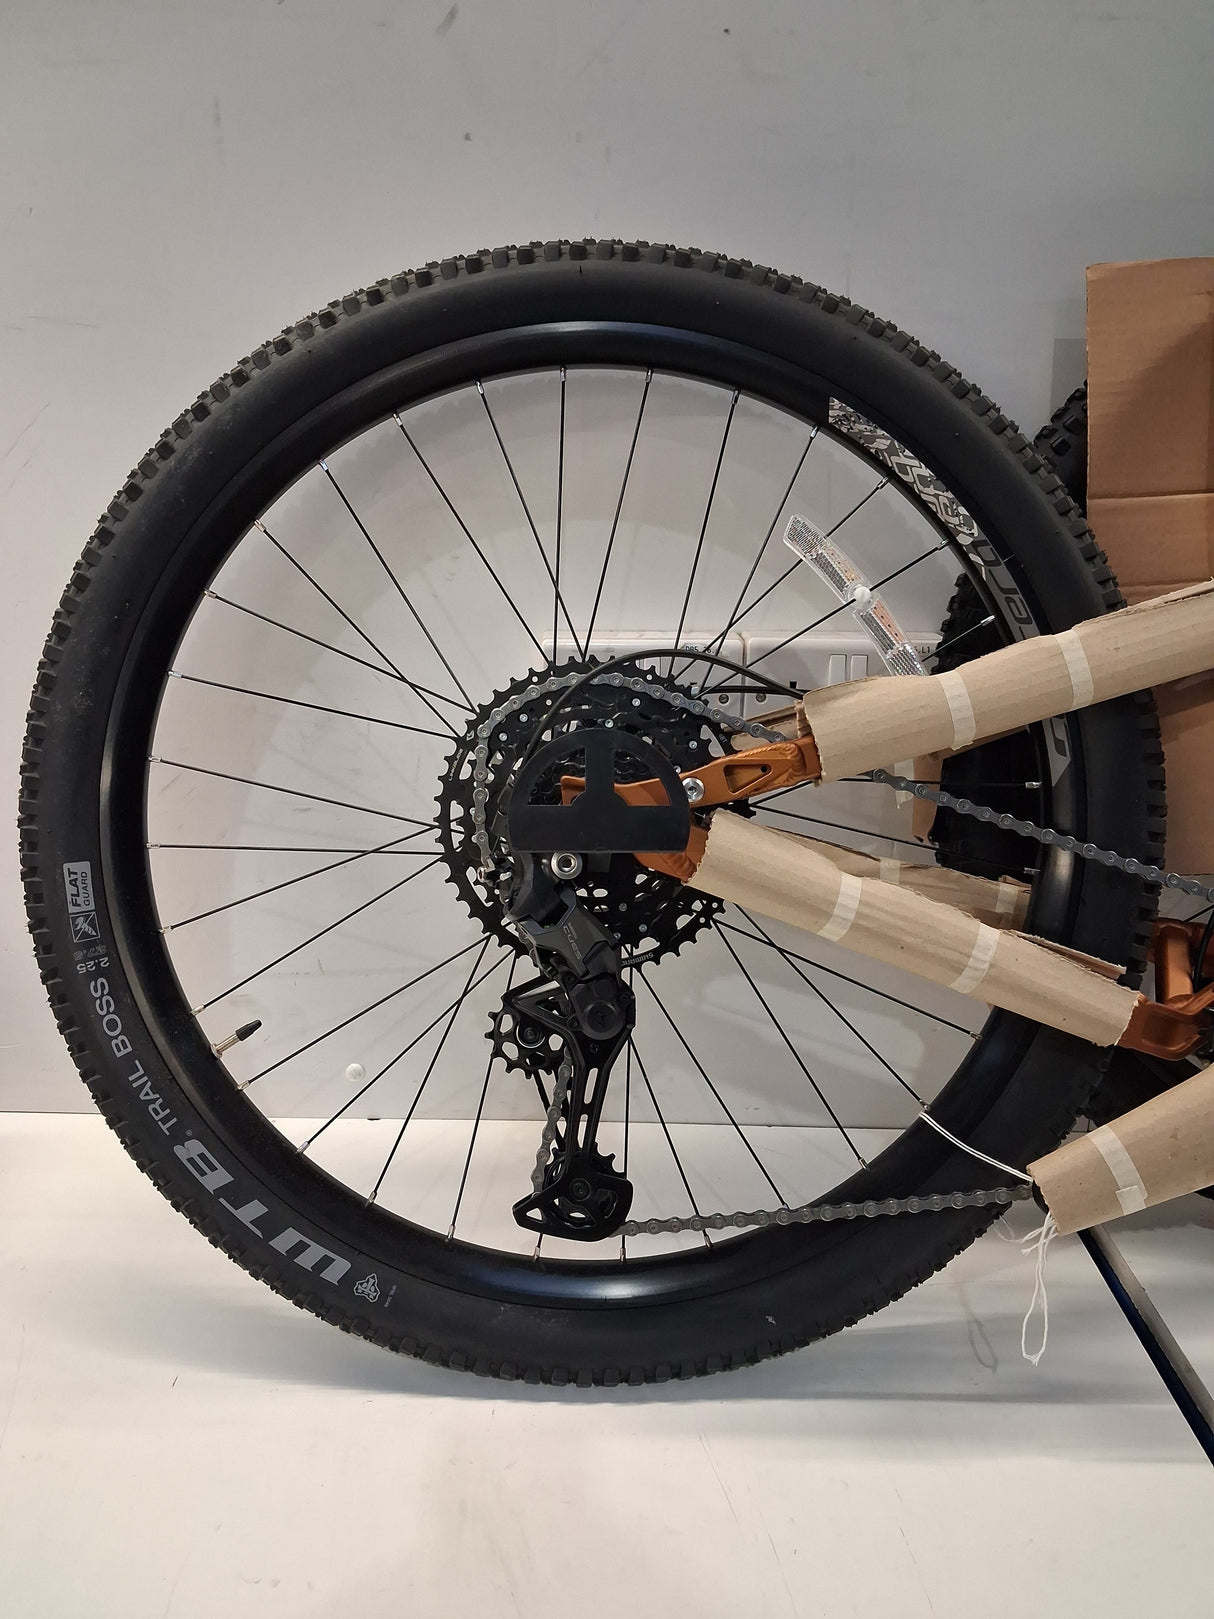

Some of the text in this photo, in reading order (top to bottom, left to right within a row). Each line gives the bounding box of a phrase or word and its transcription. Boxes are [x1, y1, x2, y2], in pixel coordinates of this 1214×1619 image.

[68, 867, 82, 908] FLAT
[80, 871, 91, 906] GUARD
[76, 957, 110, 974] 2.25
[89, 977, 352, 1286] WTB TRAIL BOSS
